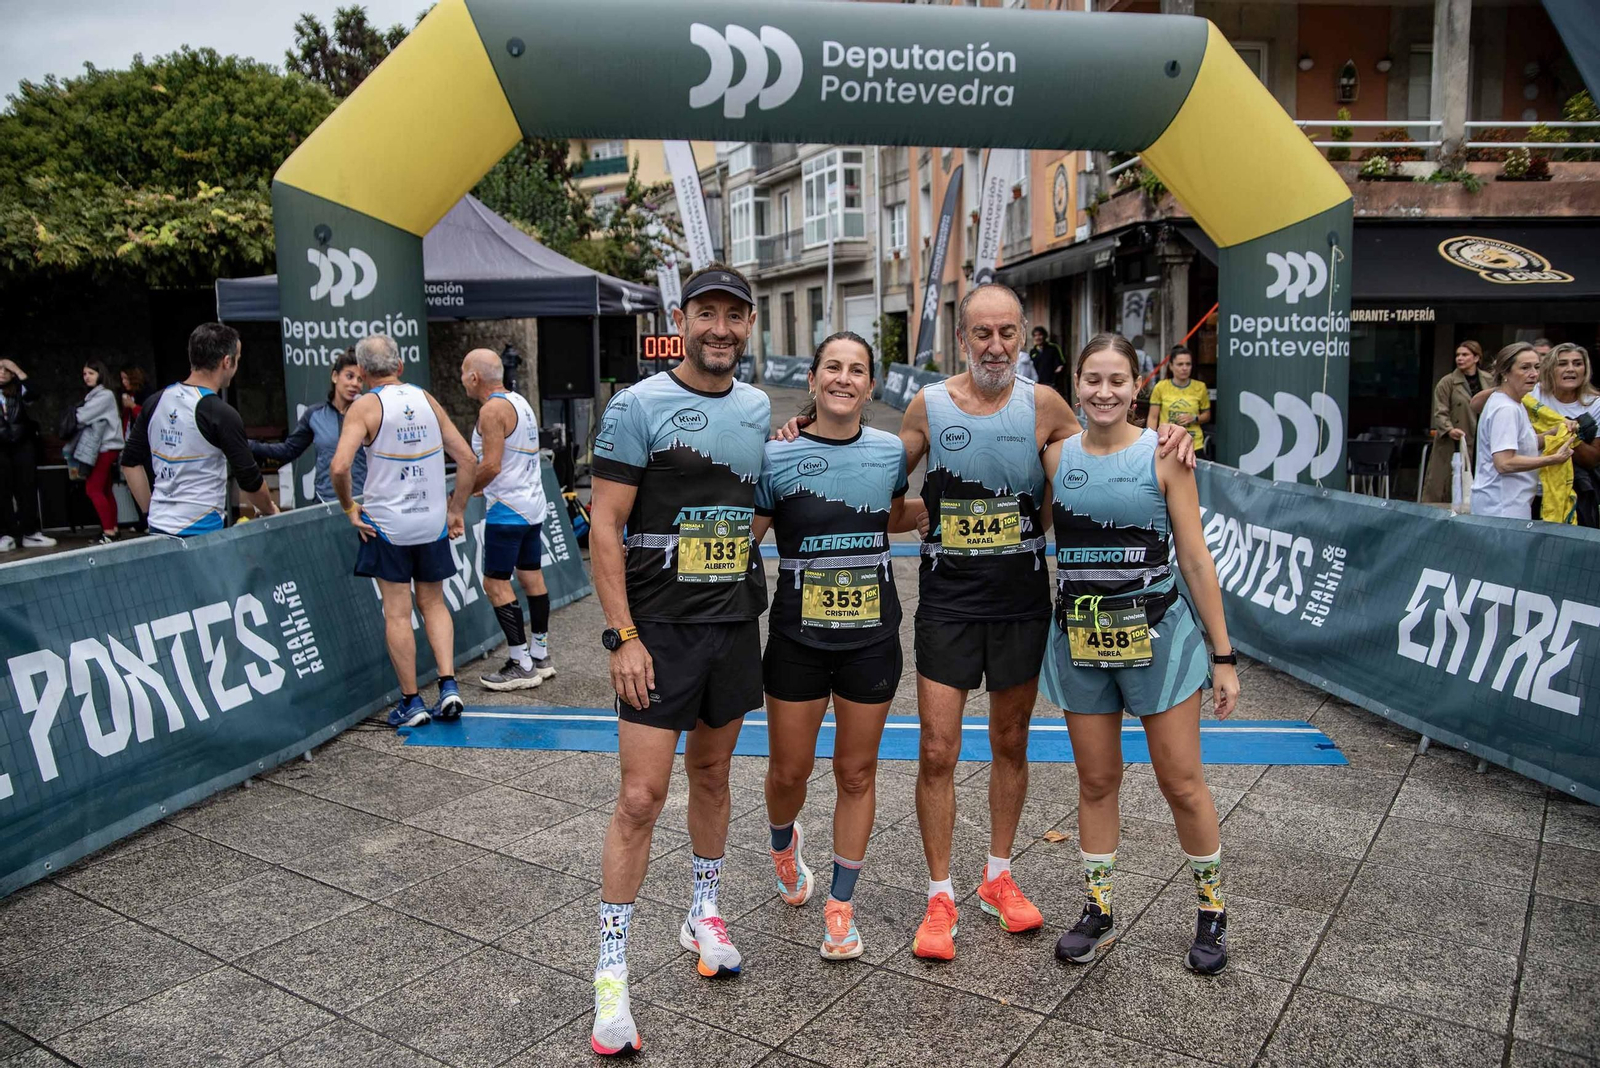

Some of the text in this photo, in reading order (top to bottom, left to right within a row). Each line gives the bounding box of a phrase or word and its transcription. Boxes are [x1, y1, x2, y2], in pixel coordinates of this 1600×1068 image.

[822, 41, 1016, 77] Deputación
[821, 74, 1015, 107] Pontevedra
[981, 176, 998, 260] Deputación
[424, 282, 464, 294] tación
[424, 295, 465, 306] vedra
[1397, 307, 1436, 322] TAPERÍA
[283, 312, 418, 346] Deputación
[1230, 310, 1350, 339] Deputación
[285, 343, 420, 366] Pontera
[645, 336, 686, 357] 00:0
[1230, 336, 1350, 357] Pontevedra
[678, 414, 701, 423] Kiwi
[946, 432, 965, 442] Kiwi
[803, 461, 822, 470] Kiwi
[958, 518, 1002, 536] 344
[1003, 515, 1017, 525] 10K
[966, 537, 994, 545] RAFAEL
[703, 542, 736, 561] 133
[704, 562, 735, 570] ALBERTO
[1203, 512, 1314, 615] PONTES
[865, 588, 877, 598] 10K
[1300, 545, 1337, 622] TRAIL &
[1311, 546, 1347, 628] RUNNING
[822, 590, 863, 608] 353
[825, 609, 860, 617] CRISTINA
[273, 584, 312, 679] TRAIL &
[283, 580, 325, 674] RUNNING
[1131, 628, 1147, 639] 10K
[1087, 631, 1130, 649] 458
[1397, 567, 1600, 716] ENTRE
[7, 593, 286, 782] PONTES
